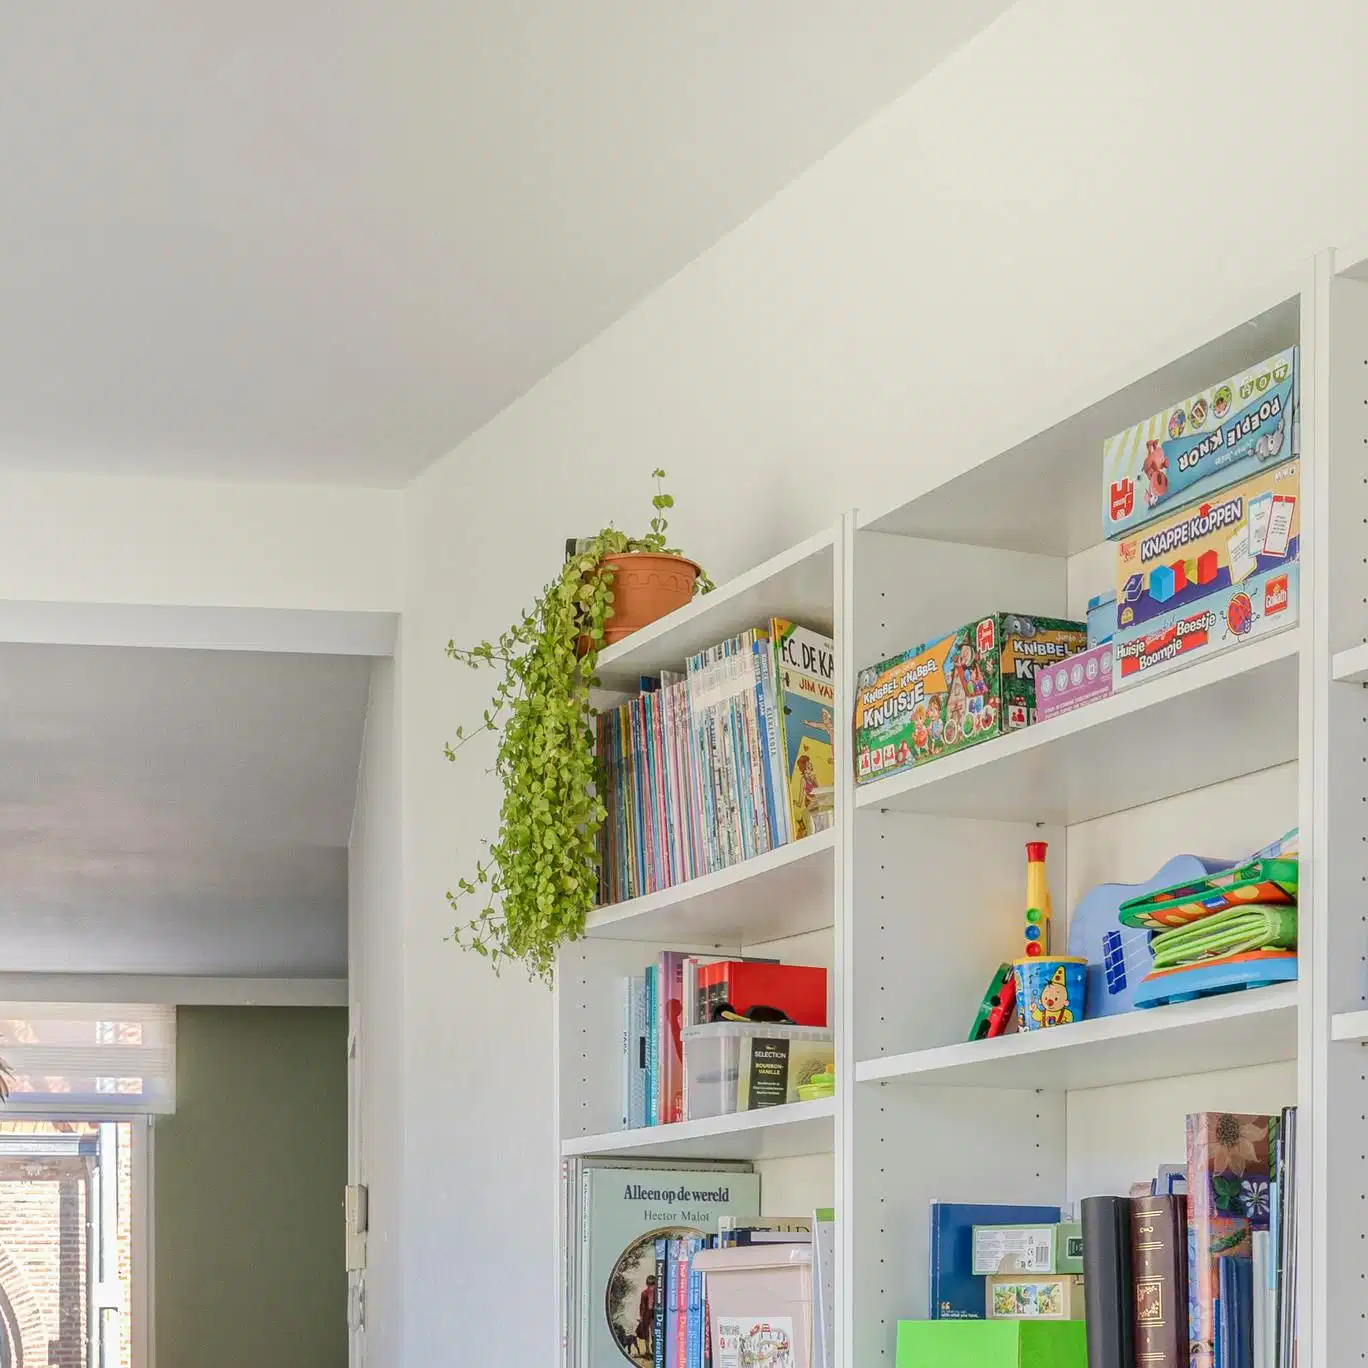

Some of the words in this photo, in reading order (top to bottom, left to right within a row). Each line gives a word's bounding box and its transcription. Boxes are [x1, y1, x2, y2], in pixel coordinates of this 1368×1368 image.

[1227, 395, 1281, 448] POEPIE
[1178, 426, 1224, 472] KNOR
[1141, 520, 1188, 563] KNAPPE
[1190, 497, 1243, 539] KOPPEN
[1265, 590, 1287, 608] Goliath
[1013, 640, 1073, 656] KNIBBEL
[1116, 639, 1145, 660] Huisje
[1176, 613, 1217, 636] Beestje
[802, 642, 819, 671] DE
[1139, 638, 1182, 670] Boompje
[799, 681, 815, 692] JIM
[864, 679, 898, 705] KNIBBEL
[901, 659, 938, 688] KNABBEL
[863, 682, 925, 730] KNUISJE
[754, 1051, 786, 1059] SELECTION
[624, 1184, 661, 1201] Alleen
[662, 1190, 676, 1204] op
[677, 1186, 692, 1201] de
[692, 1187, 729, 1202] wereld
[643, 1210, 677, 1221] Hector
[681, 1210, 710, 1222] Malot
[657, 1313, 664, 1326] De
